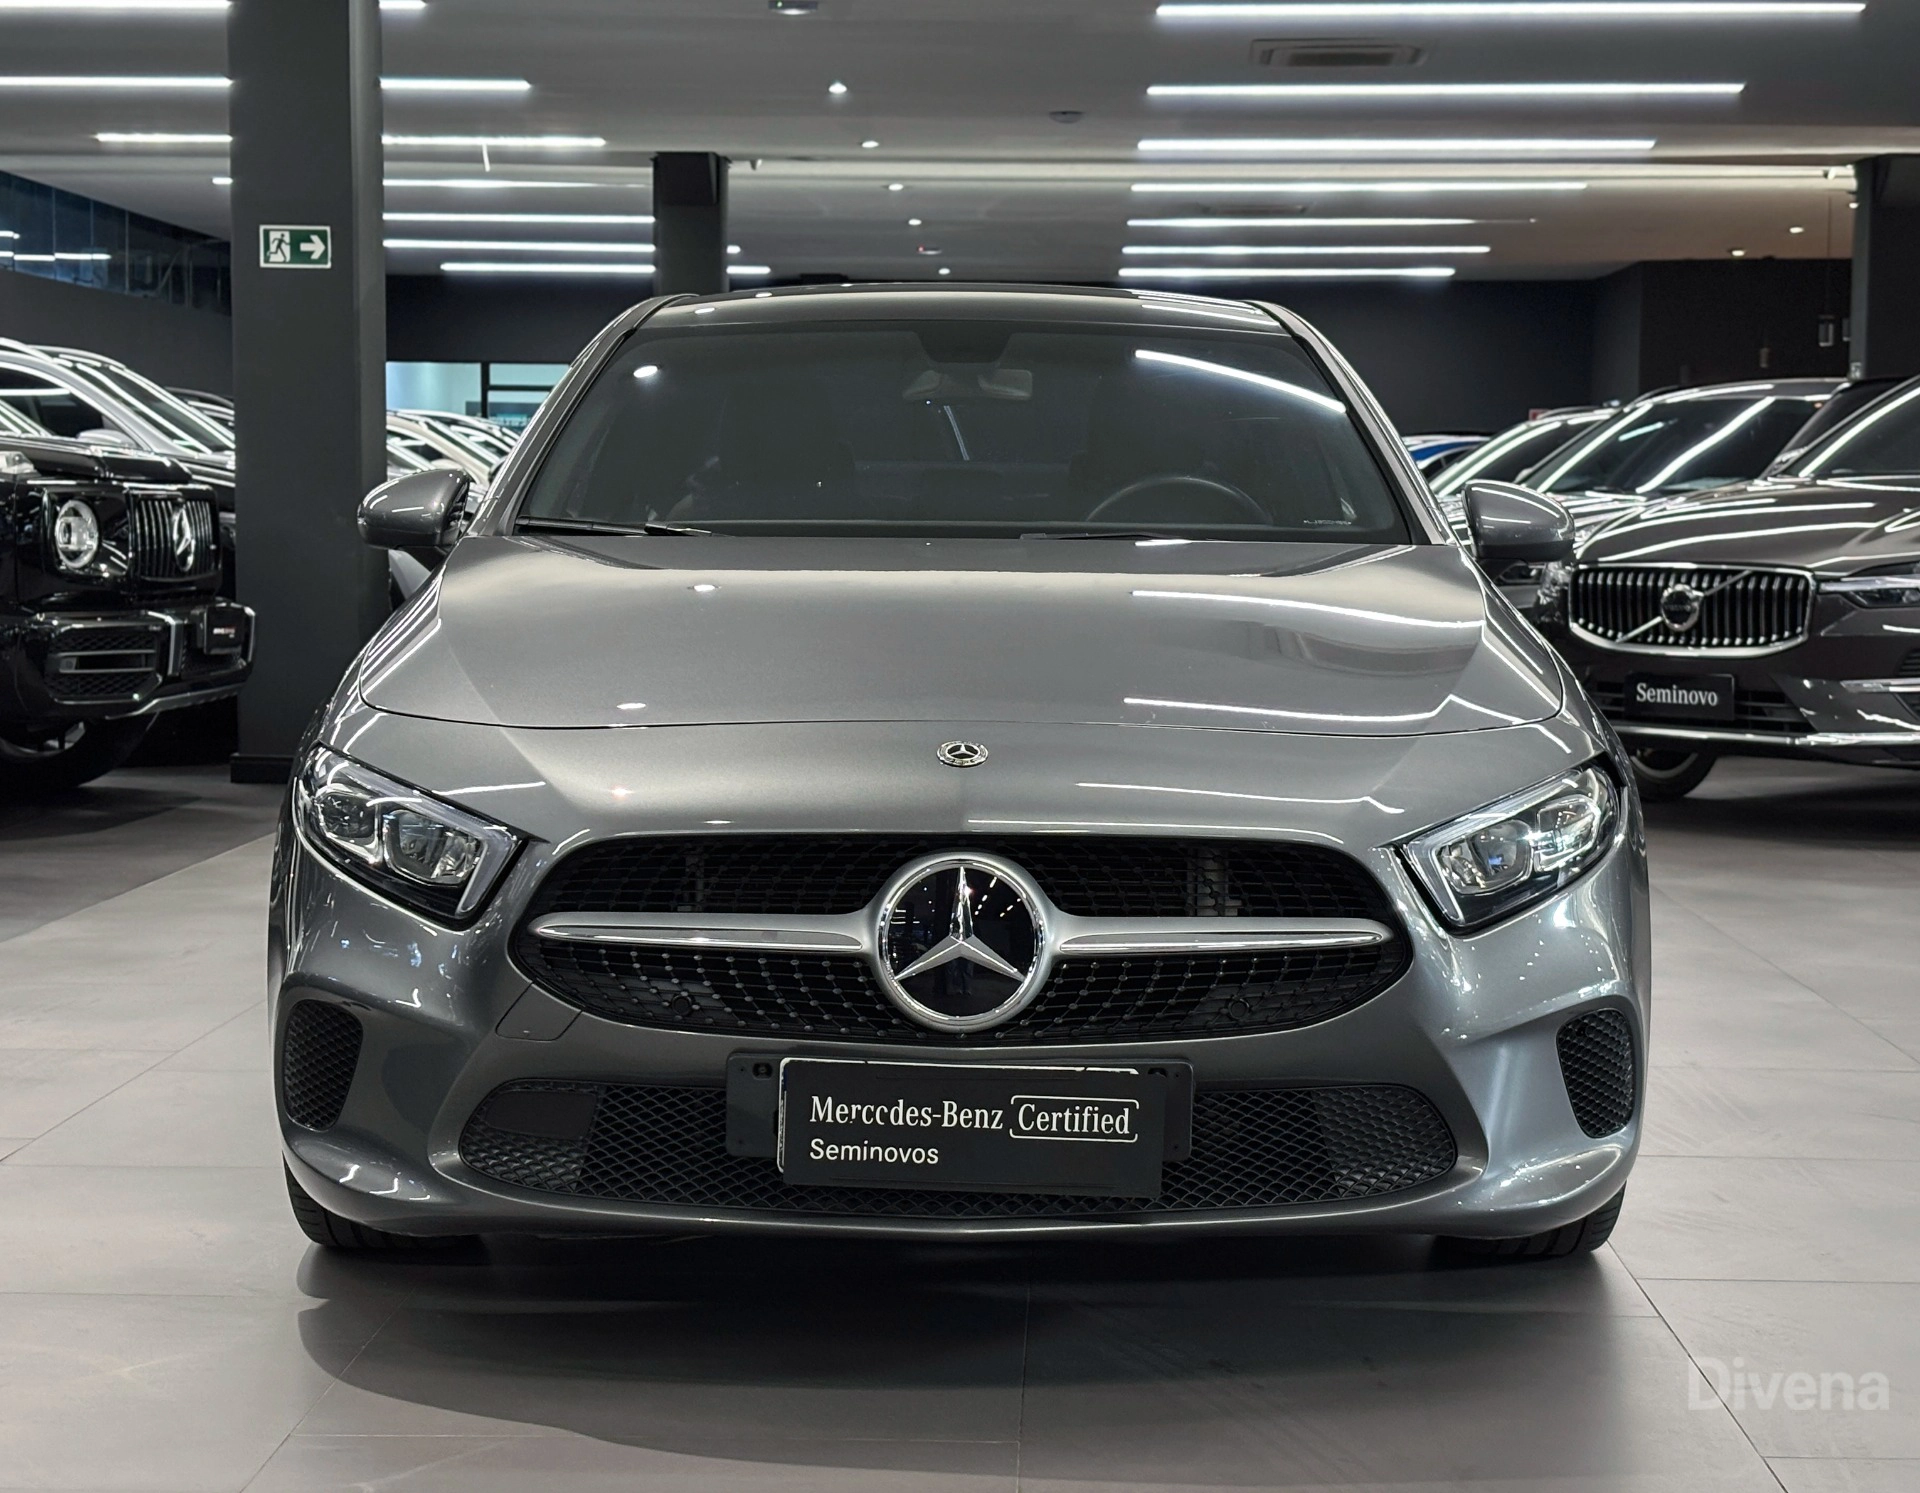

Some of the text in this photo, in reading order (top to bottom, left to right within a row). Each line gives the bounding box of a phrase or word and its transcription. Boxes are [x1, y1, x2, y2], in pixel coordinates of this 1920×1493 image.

[1636, 682, 1718, 707] Seminovo
[1018, 1103, 1131, 1135] Certified
[809, 1138, 939, 1165] Seminovos
